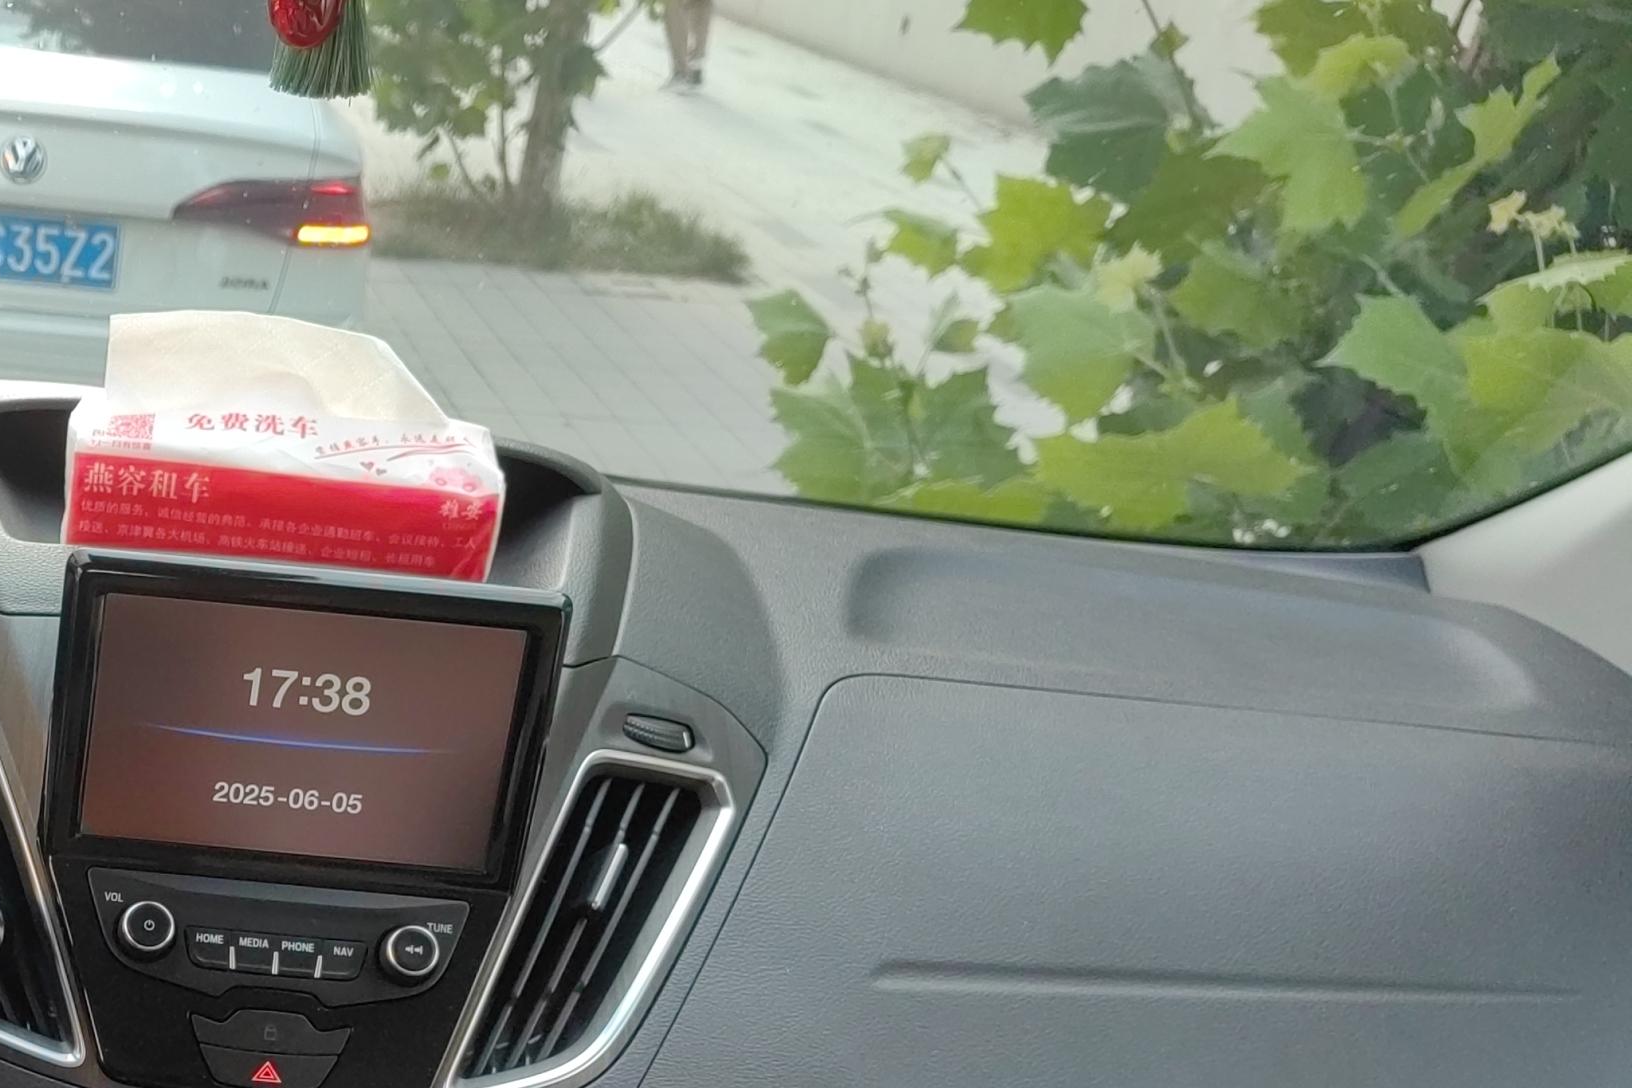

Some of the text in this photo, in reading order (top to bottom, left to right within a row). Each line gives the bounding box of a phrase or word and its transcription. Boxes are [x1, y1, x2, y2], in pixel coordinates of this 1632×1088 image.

[186, 412, 319, 439] 免费洗车
[84, 462, 210, 504] 燕容租车
[243, 667, 371, 716] 17:38
[213, 782, 363, 815] 2025-06-05
[104, 891, 124, 903] VOL
[427, 922, 453, 934] TUNE
[195, 932, 354, 957] HOME MEDIA PHONE NAV
